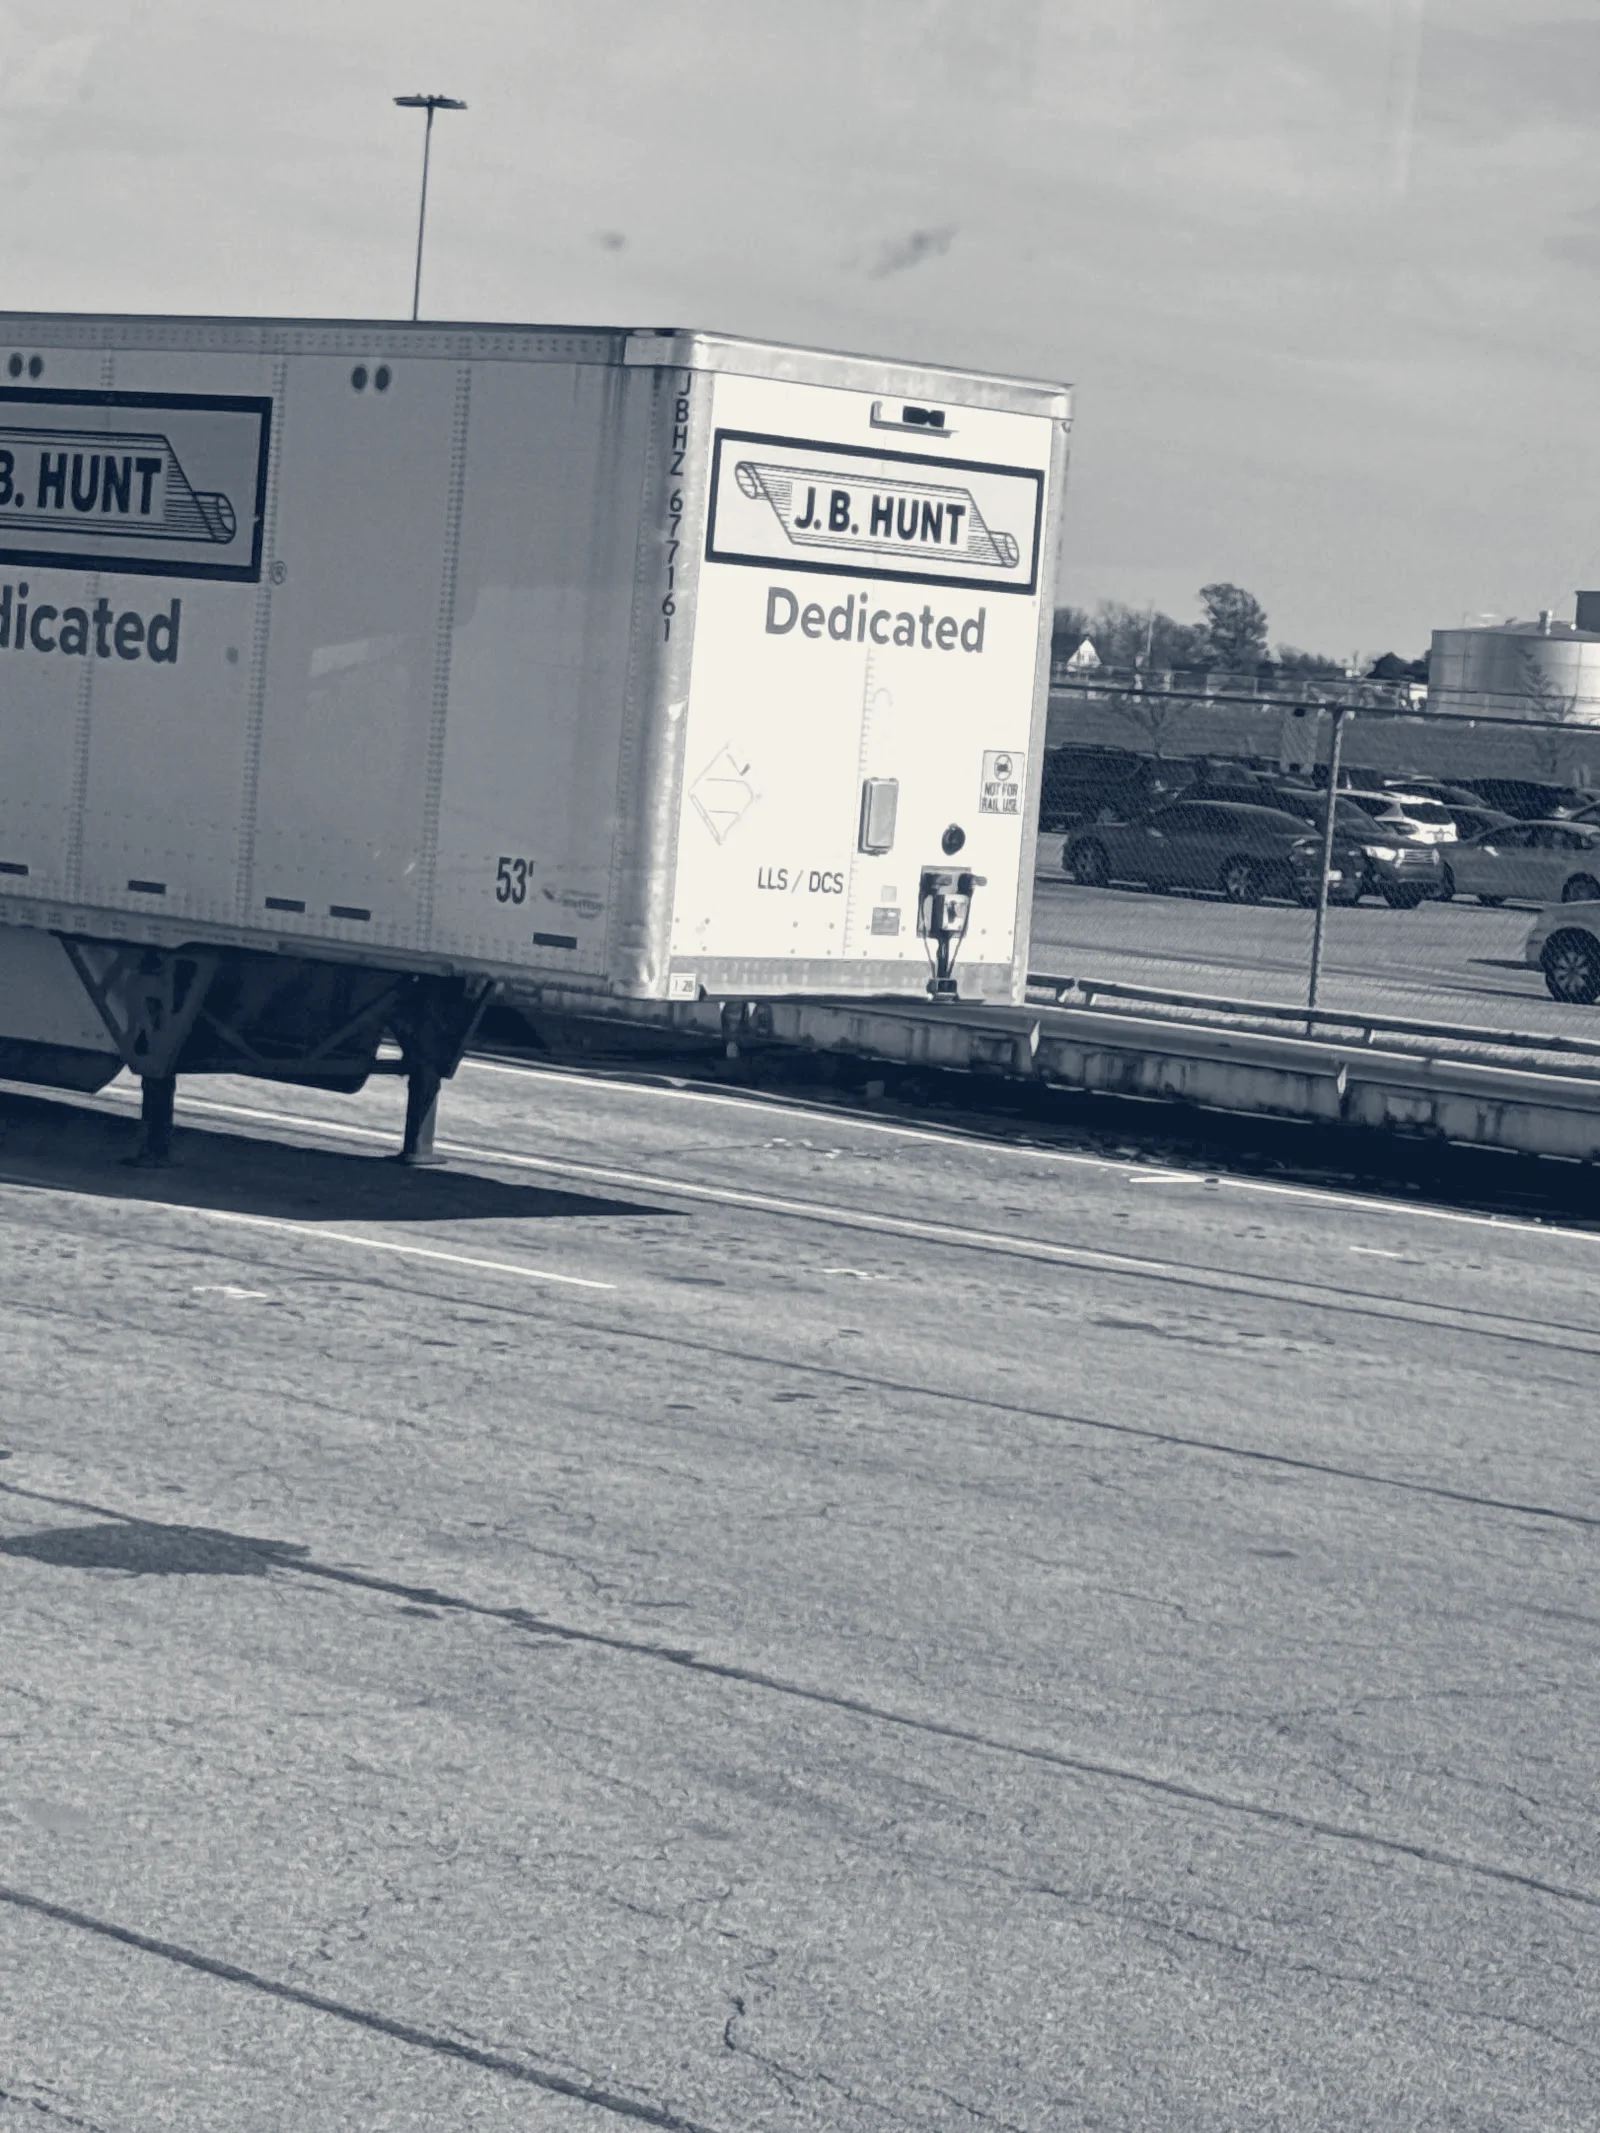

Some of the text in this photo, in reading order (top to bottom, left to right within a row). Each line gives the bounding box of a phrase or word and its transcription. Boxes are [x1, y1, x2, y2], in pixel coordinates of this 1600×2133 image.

[37, 452, 162, 515] HUNT
[661, 371, 692, 642] JBHZ 677161
[794, 486, 966, 545] J.B. HUNT
[765, 586, 987, 654] Dedicated
[981, 797, 1018, 813] RAIL USE
[985, 781, 1018, 798] NOT FOR
[496, 856, 535, 906] 53'
